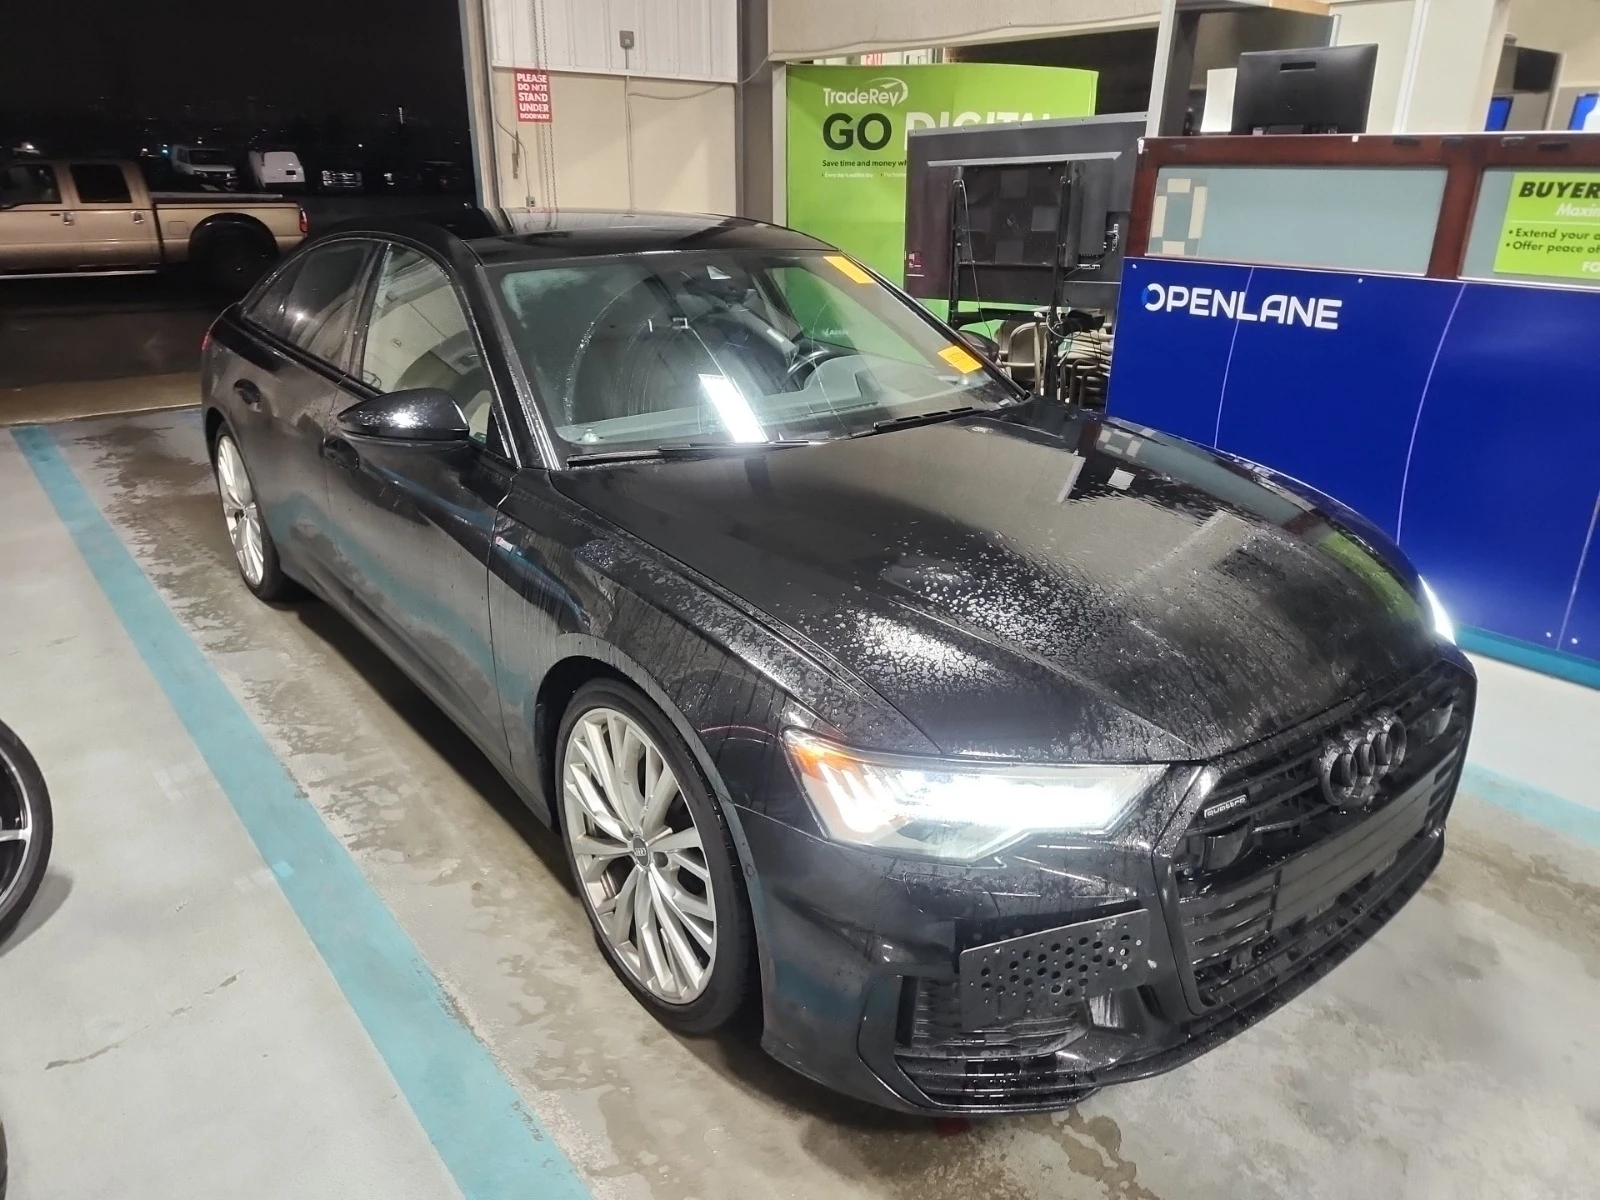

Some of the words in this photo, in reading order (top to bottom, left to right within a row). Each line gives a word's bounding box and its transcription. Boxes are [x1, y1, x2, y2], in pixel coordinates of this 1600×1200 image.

[516, 72, 548, 83] PLEASE
[517, 83, 530, 91] DO
[531, 84, 548, 92] NOT
[518, 92, 548, 102] STAND
[823, 87, 901, 107] TradeRev
[519, 103, 549, 112] UNDER
[822, 112, 893, 151] GO
[822, 159, 839, 167] Save
[840, 159, 856, 167] time
[857, 159, 871, 167] and
[872, 160, 897, 168] money
[1515, 228, 1558, 239] Extend
[1560, 231, 1590, 242] your
[1512, 240, 1544, 251] Offer
[1546, 243, 1584, 254] peace
[1141, 283, 1343, 330] OPENLANE
[1206, 796, 1247, 817] quattro
